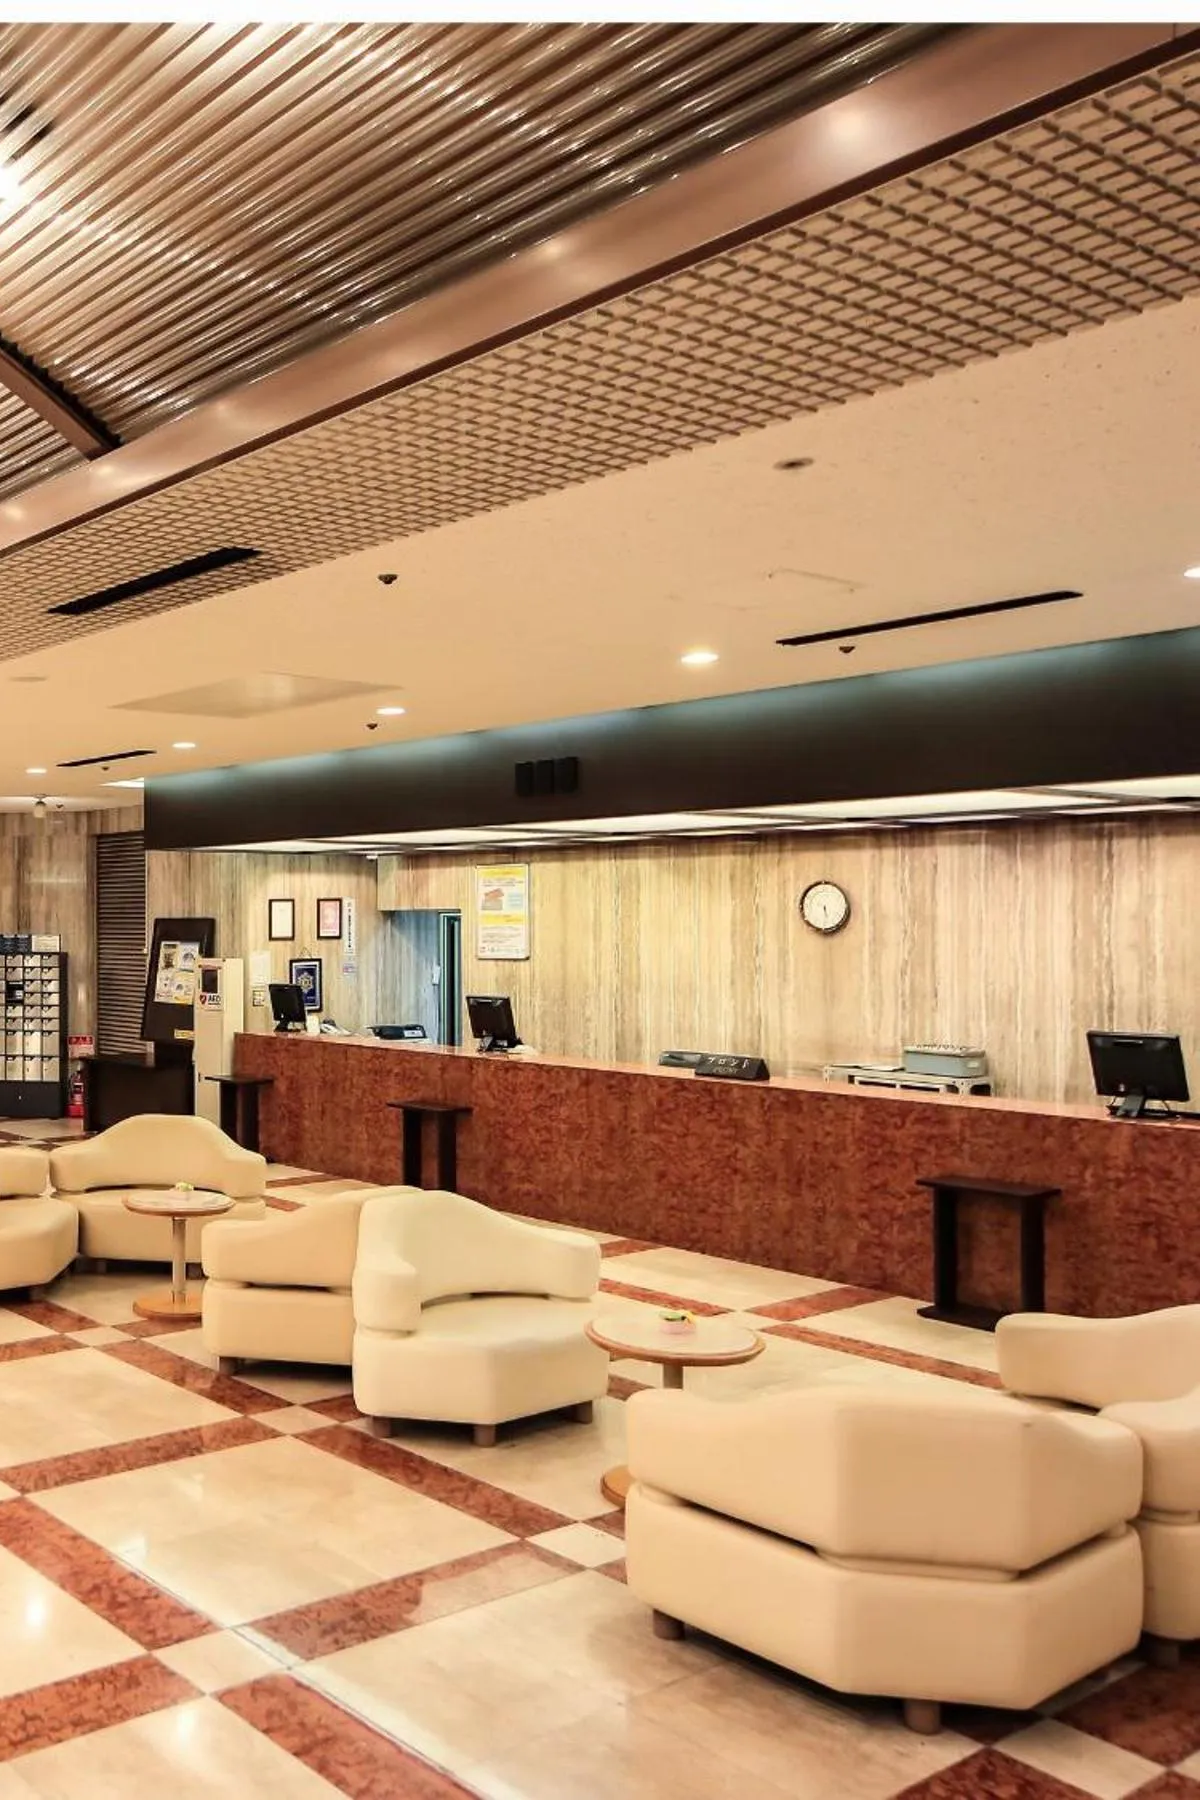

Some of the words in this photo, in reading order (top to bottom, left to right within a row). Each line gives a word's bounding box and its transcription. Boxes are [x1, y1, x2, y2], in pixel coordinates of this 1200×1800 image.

[207, 994, 221, 1002] AED
[707, 1057, 750, 1069] フロント
